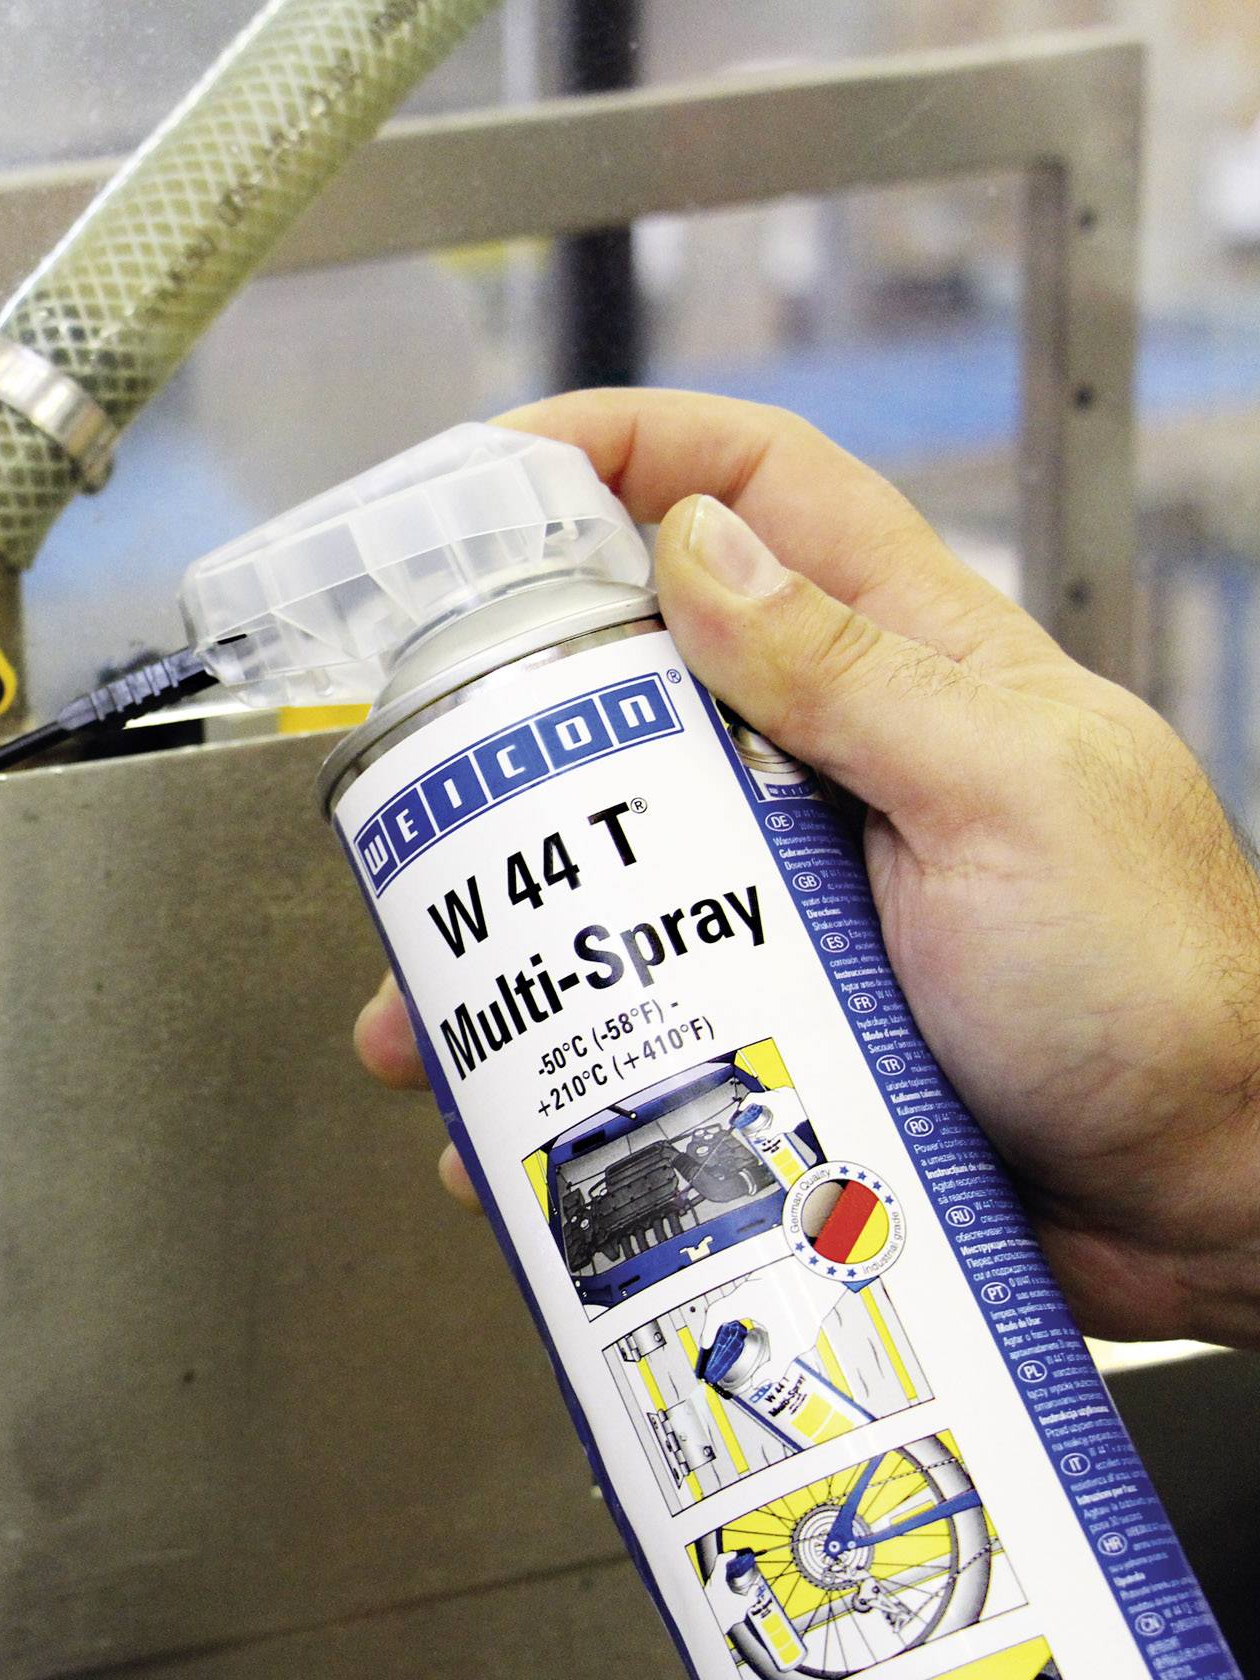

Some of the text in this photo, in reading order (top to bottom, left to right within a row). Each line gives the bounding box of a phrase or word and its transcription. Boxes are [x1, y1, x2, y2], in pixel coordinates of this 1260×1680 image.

[364, 694, 655, 876] WEICON
[771, 816, 789, 828] DE
[798, 876, 817, 888] GB
[427, 875, 490, 959] W
[506, 832, 581, 911] 44
[827, 936, 844, 949] ES
[440, 886, 766, 1081] Multi-Spray
[853, 996, 872, 1010] FR
[538, 1034, 588, 1077] -50°C
[591, 999, 665, 1053] (-58°F)
[538, 1015, 715, 1118] +210°C (+410°F)
[881, 1059, 900, 1072] TR
[910, 1119, 929, 1134] RO
[951, 1209, 970, 1223] RU
[987, 1285, 1004, 1300] PT
[1023, 1365, 1042, 1379] PL
